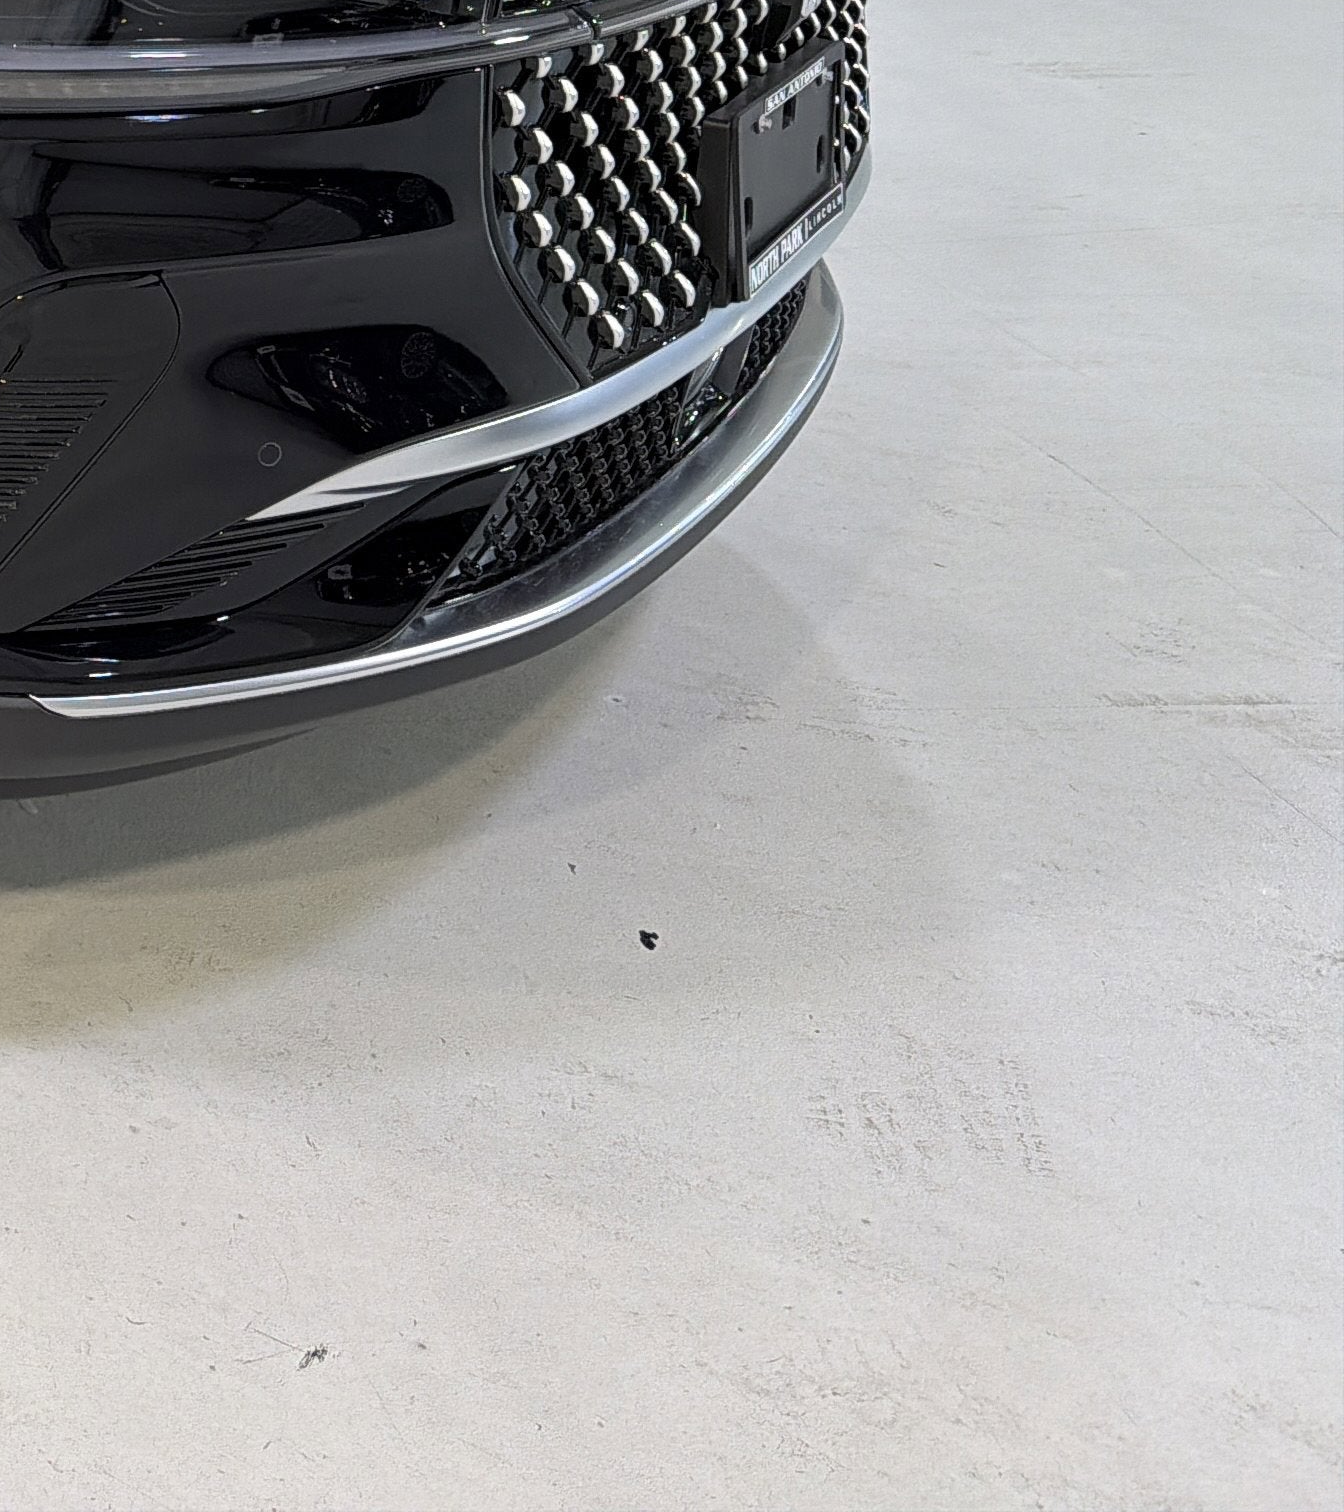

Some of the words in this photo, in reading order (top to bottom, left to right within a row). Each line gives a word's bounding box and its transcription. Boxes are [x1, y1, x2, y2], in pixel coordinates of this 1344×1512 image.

[766, 88, 786, 111] SAN
[750, 245, 780, 293] NORTH
[780, 222, 804, 264] PARK
